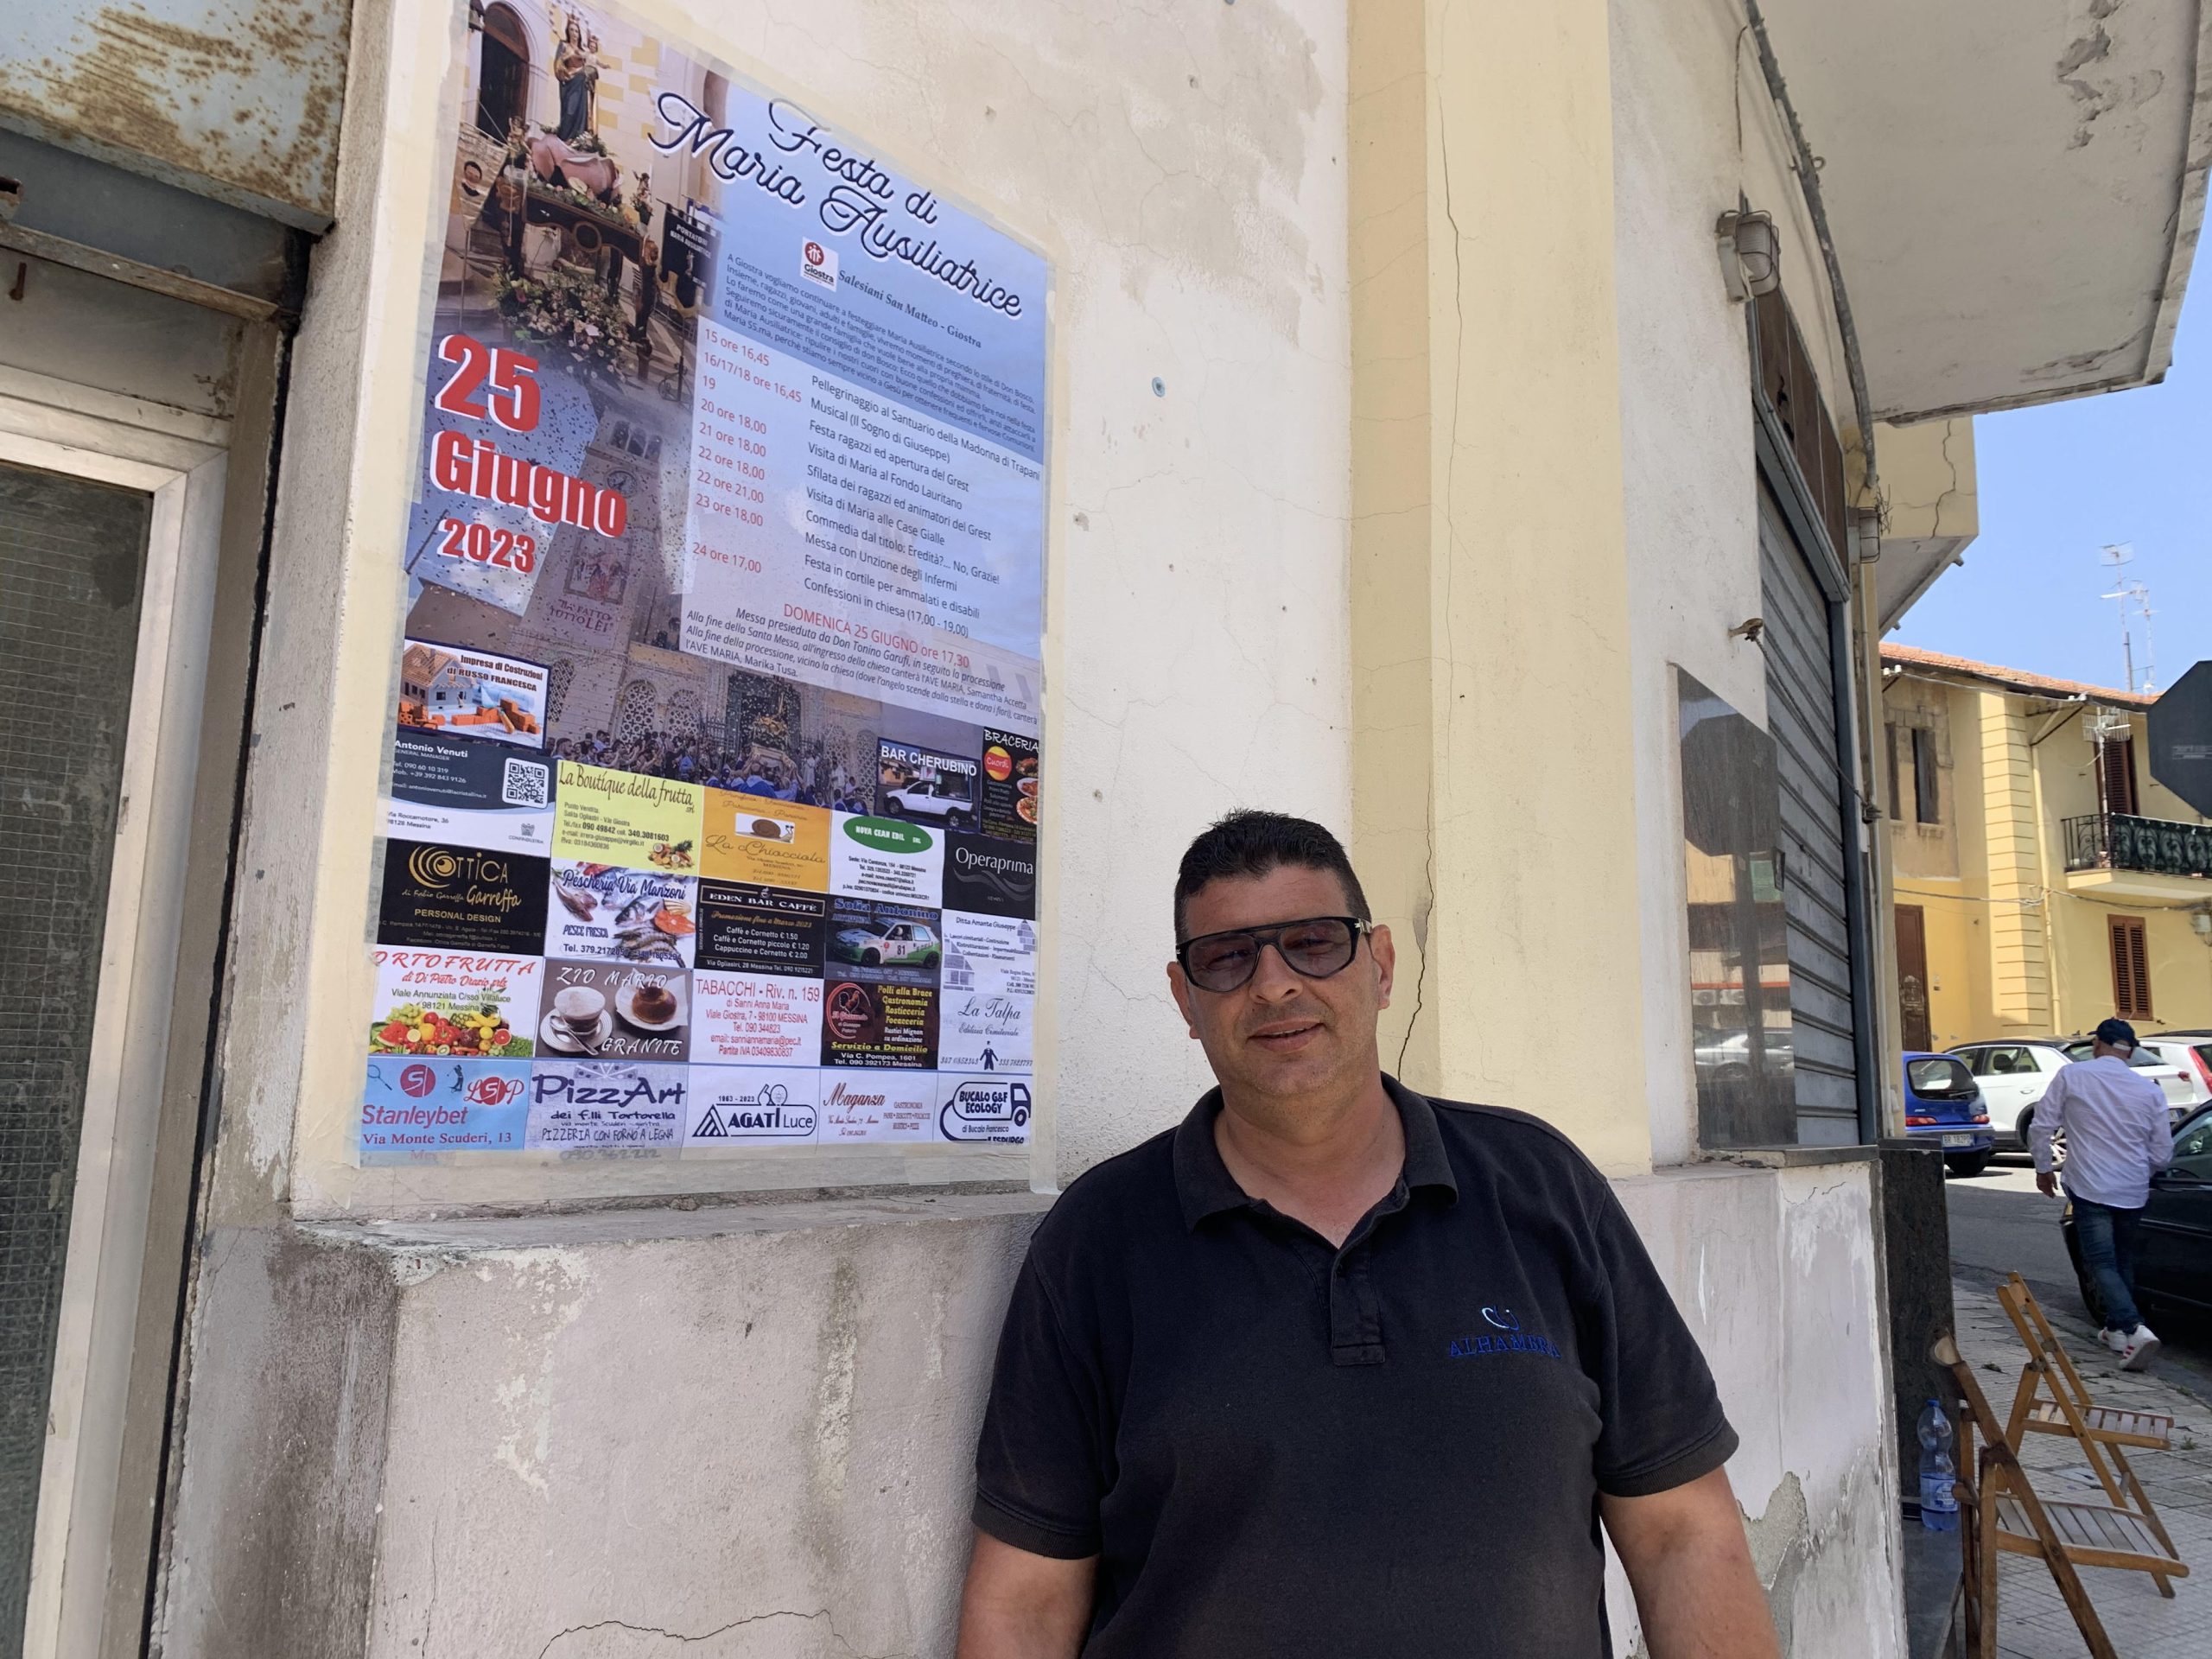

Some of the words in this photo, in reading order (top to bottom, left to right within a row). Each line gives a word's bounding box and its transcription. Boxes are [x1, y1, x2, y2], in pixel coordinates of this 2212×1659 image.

[768, 99, 894, 200] Festa
[906, 190, 938, 225] di
[648, 92, 806, 206] Maria
[820, 184, 1022, 317] Ausiliatrice
[804, 262, 834, 283] Giostra
[838, 269, 883, 301] Salesiani
[885, 292, 903, 310] San
[904, 302, 938, 327] Matteo
[947, 322, 982, 348] Giostra
[704, 327, 717, 344] 15
[720, 337, 738, 353] ore
[741, 344, 769, 367] 16,45
[435, 334, 540, 432] 25
[702, 374, 715, 391] 19
[703, 351, 750, 381] 16/17/18
[753, 375, 771, 391] ore
[774, 381, 802, 404] 16,45
[700, 397, 715, 414] 20
[716, 407, 734, 423] ore
[739, 413, 766, 435] 18,00
[811, 375, 879, 413] Pellegrinaggio
[880, 406, 889, 417] al
[892, 409, 935, 436] Santuario
[937, 429, 958, 447] della
[961, 438, 1000, 464] Madonna
[1001, 455, 1009, 468] di
[1011, 460, 1039, 480] Trapani
[699, 421, 712, 436] 21
[715, 430, 734, 445] ore
[738, 436, 766, 457] 18,00
[810, 397, 847, 422] Musical
[861, 417, 890, 439] Sogno
[892, 430, 901, 443] di
[903, 435, 950, 465] Giuseppe)
[810, 419, 835, 440] Festa
[838, 433, 871, 454] ragazzi
[874, 447, 887, 460] ed
[888, 453, 929, 476] apertura
[931, 467, 944, 482] del
[946, 474, 969, 492] Grest
[430, 430, 627, 538] Giugno
[808, 442, 834, 461] Visita
[837, 453, 847, 466] di
[849, 457, 876, 477] Maria
[880, 471, 888, 482] al
[890, 473, 918, 493] Fondo
[921, 485, 962, 510] Lauritano
[696, 493, 709, 508] 23
[713, 501, 731, 516] ore
[734, 506, 763, 526] 18,00
[437, 518, 535, 573] 2023
[693, 541, 707, 556] 24
[710, 549, 728, 563] ore
[732, 553, 761, 573] 17,00
[805, 509, 858, 537] Commedia
[861, 528, 876, 543] dal
[879, 535, 905, 553] titolo:
[953, 559, 968, 575] No,
[970, 565, 1000, 584] Grazie!
[805, 531, 836, 552] Messa
[839, 545, 856, 558] con
[859, 550, 898, 572] Unzione
[900, 563, 922, 581] degli
[925, 571, 957, 591] Infermi
[804, 554, 830, 573] Festa
[833, 563, 842, 576] in
[845, 569, 874, 586] cortile
[877, 579, 893, 592] per
[895, 585, 939, 606] ammalati
[941, 599, 947, 608] e
[949, 600, 979, 619] disabili
[784, 603, 851, 634] DOMENICA
[854, 623, 868, 639] 25
[871, 628, 918, 653] GIUGNO
[920, 645, 938, 659] ore
[942, 649, 969, 668] 17,30
[447, 665, 456, 674] di
[458, 668, 488, 681] RUSSO
[490, 675, 537, 691] FRANCESCA
[461, 654, 493, 669] Impresa
[494, 662, 503, 671] di
[504, 664, 543, 680] Costruzioni
[394, 739, 433, 752] Antonio
[436, 746, 468, 758] Venuti
[983, 728, 1039, 753] BRACERIA
[880, 746, 906, 762] BAR
[909, 752, 976, 777] CHERUBINO
[559, 761, 575, 786] La
[627, 774, 658, 800] della
[653, 779, 694, 810] frutta
[855, 825, 872, 836] NOVA
[956, 846, 1033, 874] Operaprima
[562, 868, 616, 892] Pescheria
[618, 876, 637, 894] Via
[639, 879, 686, 900] Manzoni
[466, 884, 522, 913] Garreffa
[709, 893, 741, 902] EDEN
[748, 897, 773, 906] BAR
[779, 900, 817, 912] CAFFÈ
[414, 908, 465, 919] PERSONAL
[467, 913, 500, 923] DESIGN
[897, 944, 905, 956] 81
[556, 966, 596, 986] ZIO
[604, 969, 668, 990] MARIO
[695, 978, 755, 997] TABACCHI
[766, 983, 785, 999] Riv.
[788, 989, 797, 1000] n.
[802, 986, 819, 1001] 159
[877, 985, 893, 995] Polli
[895, 987, 910, 995] alla
[912, 988, 932, 997] Brace
[881, 996, 928, 1006] Gastronomia
[885, 1006, 925, 1016] Rosticceria
[957, 995, 980, 1016] La
[984, 997, 1020, 1026] Talpa
[885, 1015, 924, 1026] Focacceria
[601, 1036, 683, 1056] GRANITE
[831, 1041, 871, 1050] Servizio
[883, 1044, 928, 1052] Domicilio
[530, 1073, 687, 1108] PizzArt
[823, 1083, 886, 1113] Maganza
[959, 1090, 989, 1102] BUCALO
[991, 1091, 1007, 1103] G&F
[360, 1103, 468, 1129] Stanleybet
[550, 1110, 571, 1119] dei
[607, 1110, 675, 1121] Tortorella
[728, 1107, 780, 1128] AGATI
[784, 1113, 813, 1128] Luce
[965, 1103, 1001, 1114] ECOLOGY
[362, 1133, 386, 1145] Via
[391, 1132, 435, 1145] Monte
[439, 1132, 493, 1146] Scuderi,
[498, 1132, 512, 1142] 13
[542, 1127, 591, 1141] PIZZERIA
[594, 1130, 610, 1141] CON
[613, 1129, 638, 1141] FORNO
[639, 1129, 646, 1141] A
[648, 1128, 674, 1141] LEGNA
[1449, 1334, 1562, 1358] ALHAMBRA
